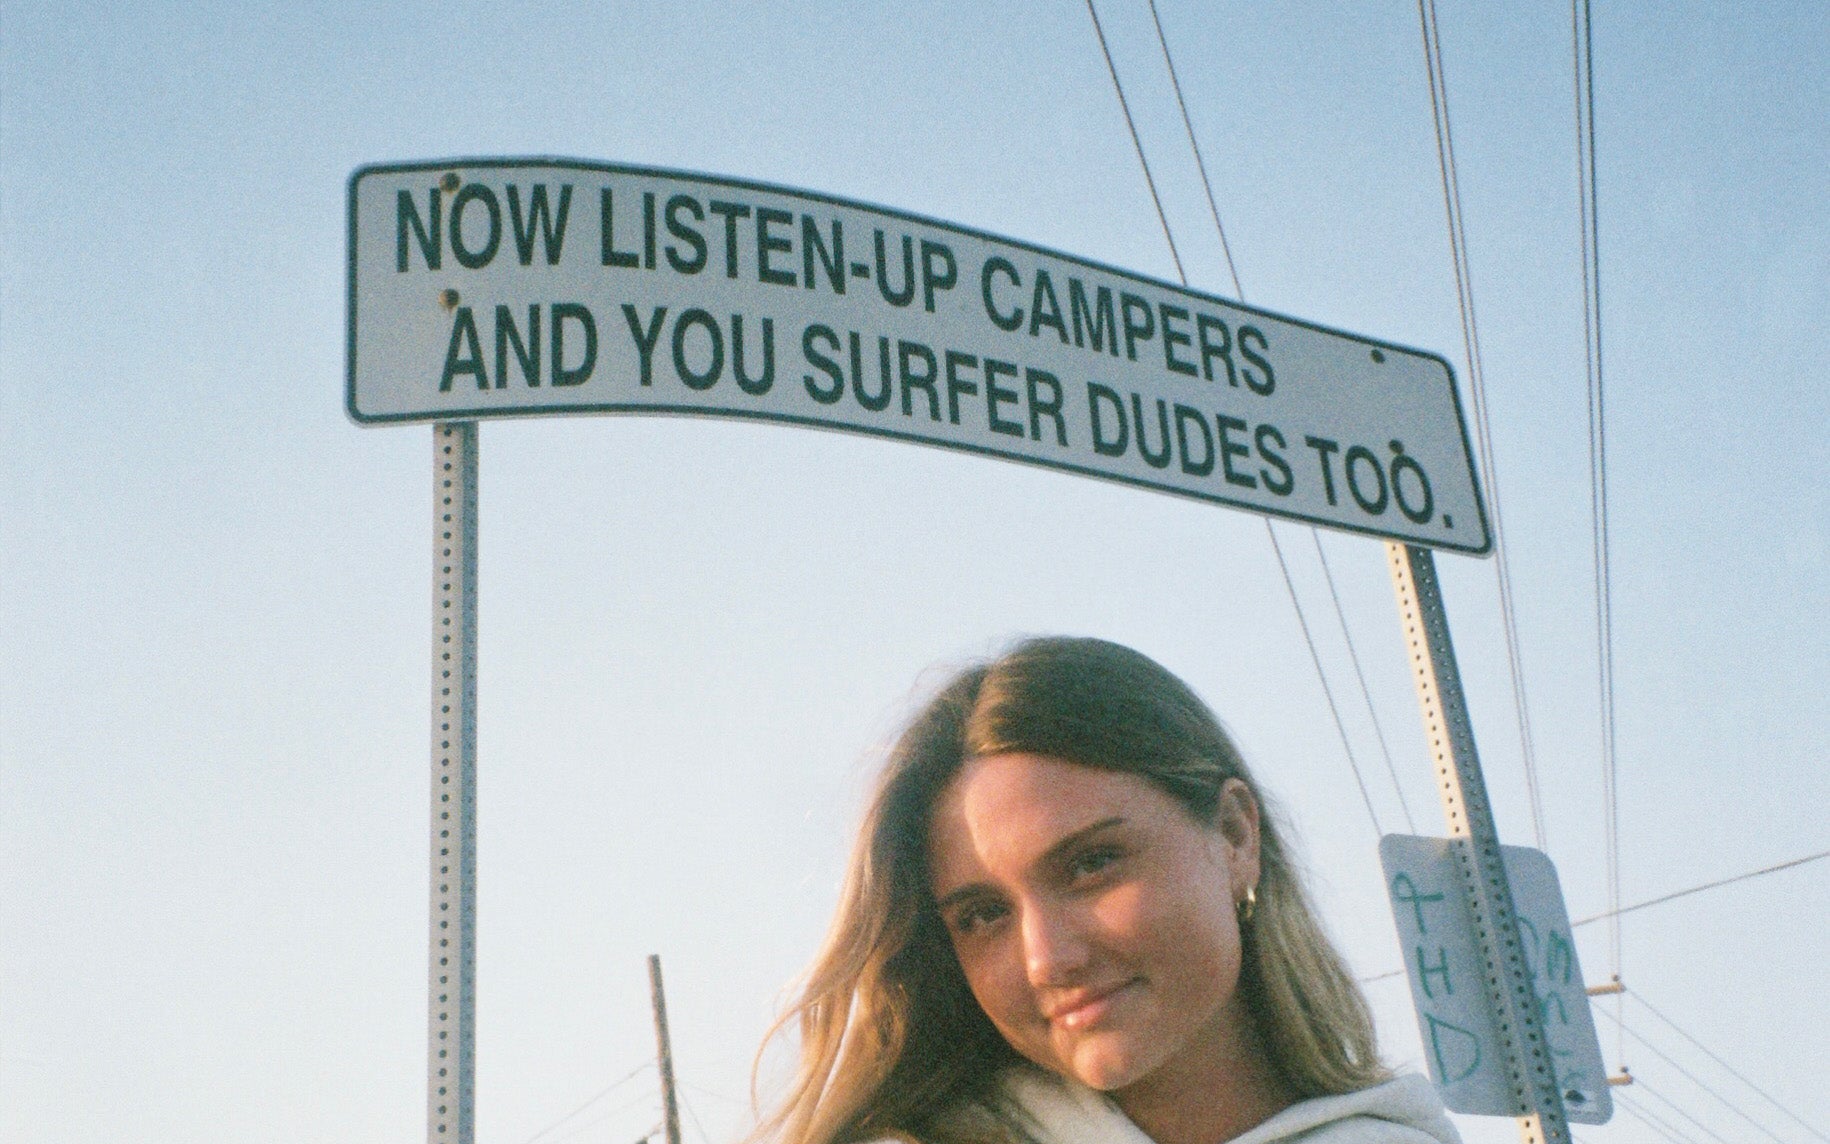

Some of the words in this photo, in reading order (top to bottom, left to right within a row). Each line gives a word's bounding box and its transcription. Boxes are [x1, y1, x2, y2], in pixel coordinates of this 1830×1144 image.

[398, 183, 573, 273] NOW
[601, 187, 957, 312] LISTEN-UP
[981, 256, 1276, 396] CAMPERS
[439, 303, 599, 392] AND
[621, 304, 775, 396] YOU
[803, 323, 1069, 447] SURFER
[1087, 381, 1294, 496] DUDES
[1305, 435, 1454, 529] TOO.
